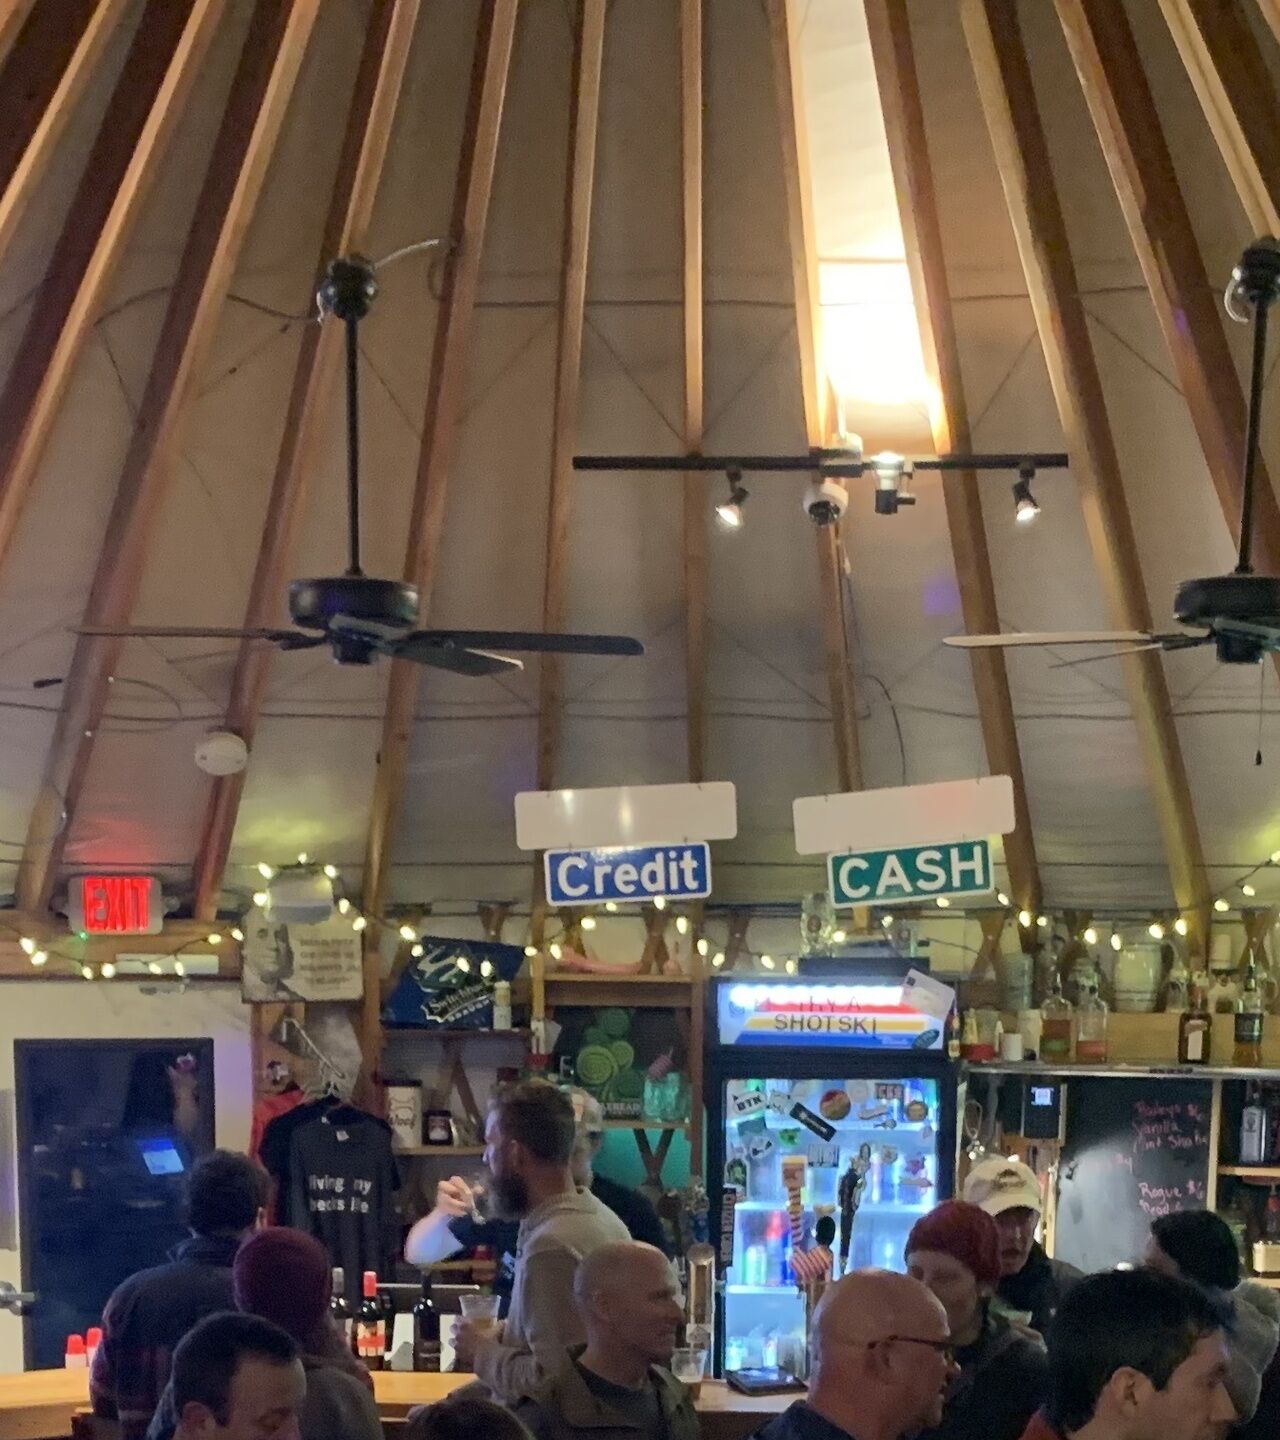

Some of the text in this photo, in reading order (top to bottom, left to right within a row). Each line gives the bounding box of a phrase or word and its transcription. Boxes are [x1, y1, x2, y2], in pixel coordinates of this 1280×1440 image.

[556, 850, 700, 897] Credit
[837, 846, 985, 899] CASH
[83, 877, 151, 931] EXIT
